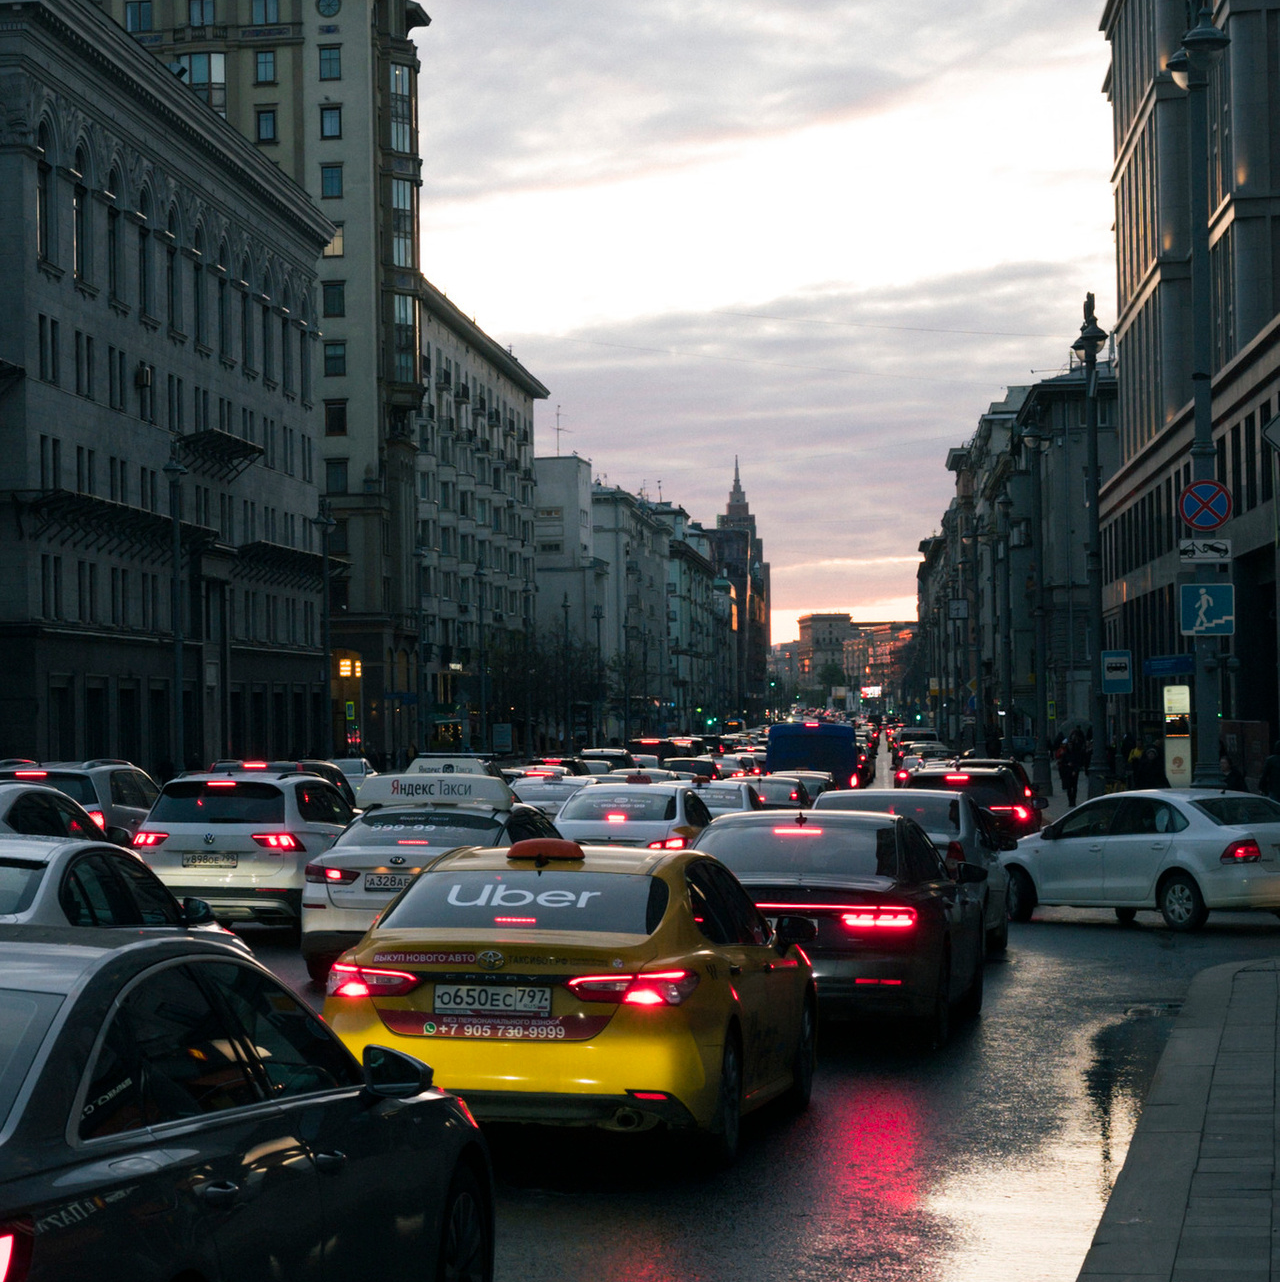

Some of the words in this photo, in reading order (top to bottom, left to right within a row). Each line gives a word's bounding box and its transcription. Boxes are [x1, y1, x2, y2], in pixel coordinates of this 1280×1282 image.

[391, 779, 435, 796] Яндекс
[437, 779, 472, 796] Такси
[447, 884, 601, 908] Uber
[373, 953, 405, 963] ВЫКУП
[406, 953, 444, 963] НОВОГО
[446, 953, 476, 963] АВТО
[517, 989, 545, 1005] 797
[458, 1017, 530, 1025] ПЕРВОНАЧАЛЬНОГО
[439, 1024, 459, 1035] +7
[464, 1024, 491, 1037] 905
[496, 1025, 565, 1038] 730-9999
